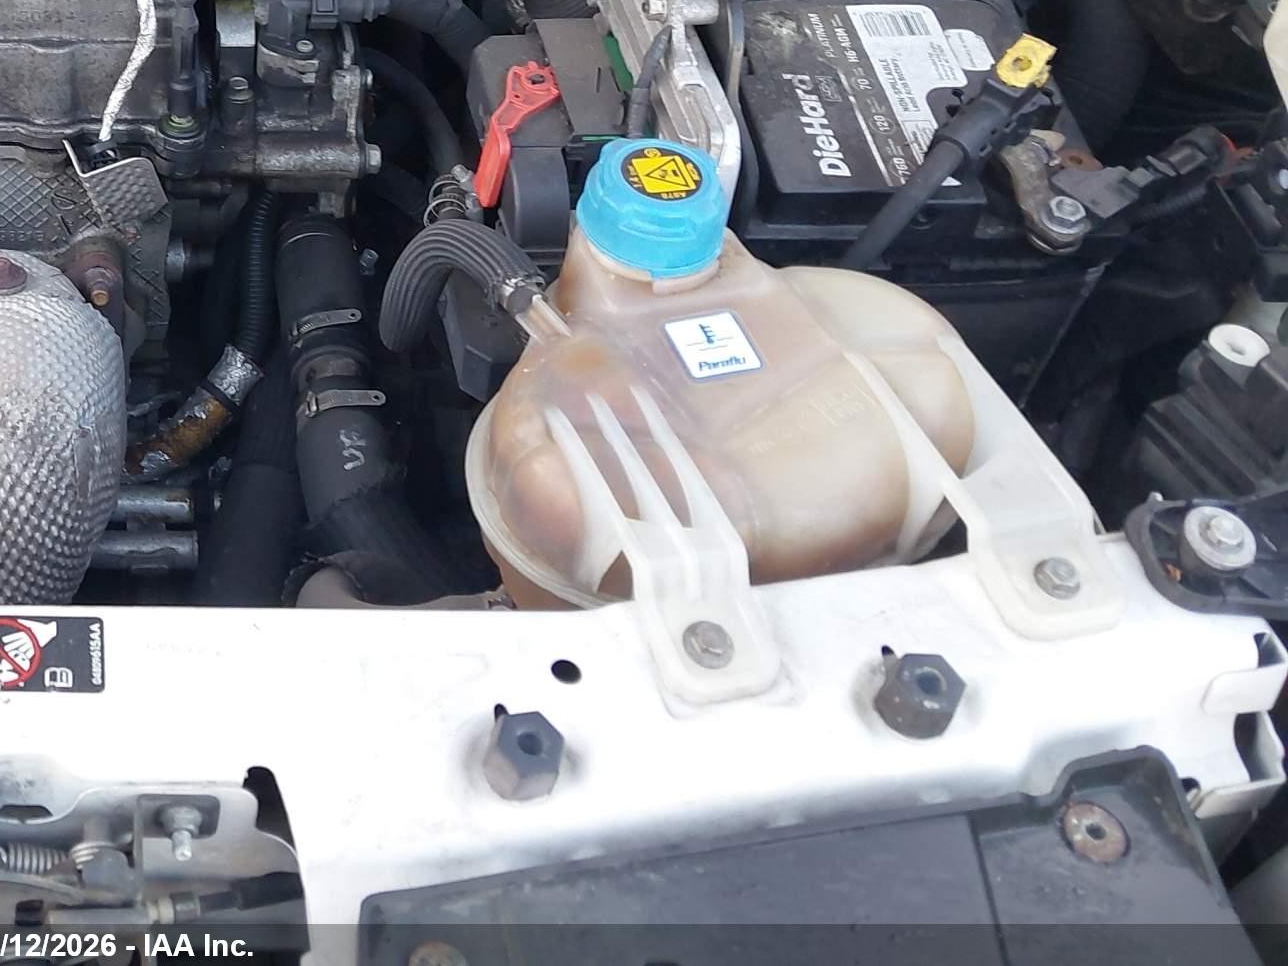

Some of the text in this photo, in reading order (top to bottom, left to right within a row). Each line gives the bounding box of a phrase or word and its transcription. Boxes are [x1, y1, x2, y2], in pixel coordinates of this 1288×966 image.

[808, 13, 838, 59] PLATINUM
[856, 78, 873, 90] 70
[781, 73, 852, 177] DieHard
[872, 114, 892, 132] 120
[698, 355, 747, 371] Paraflu
